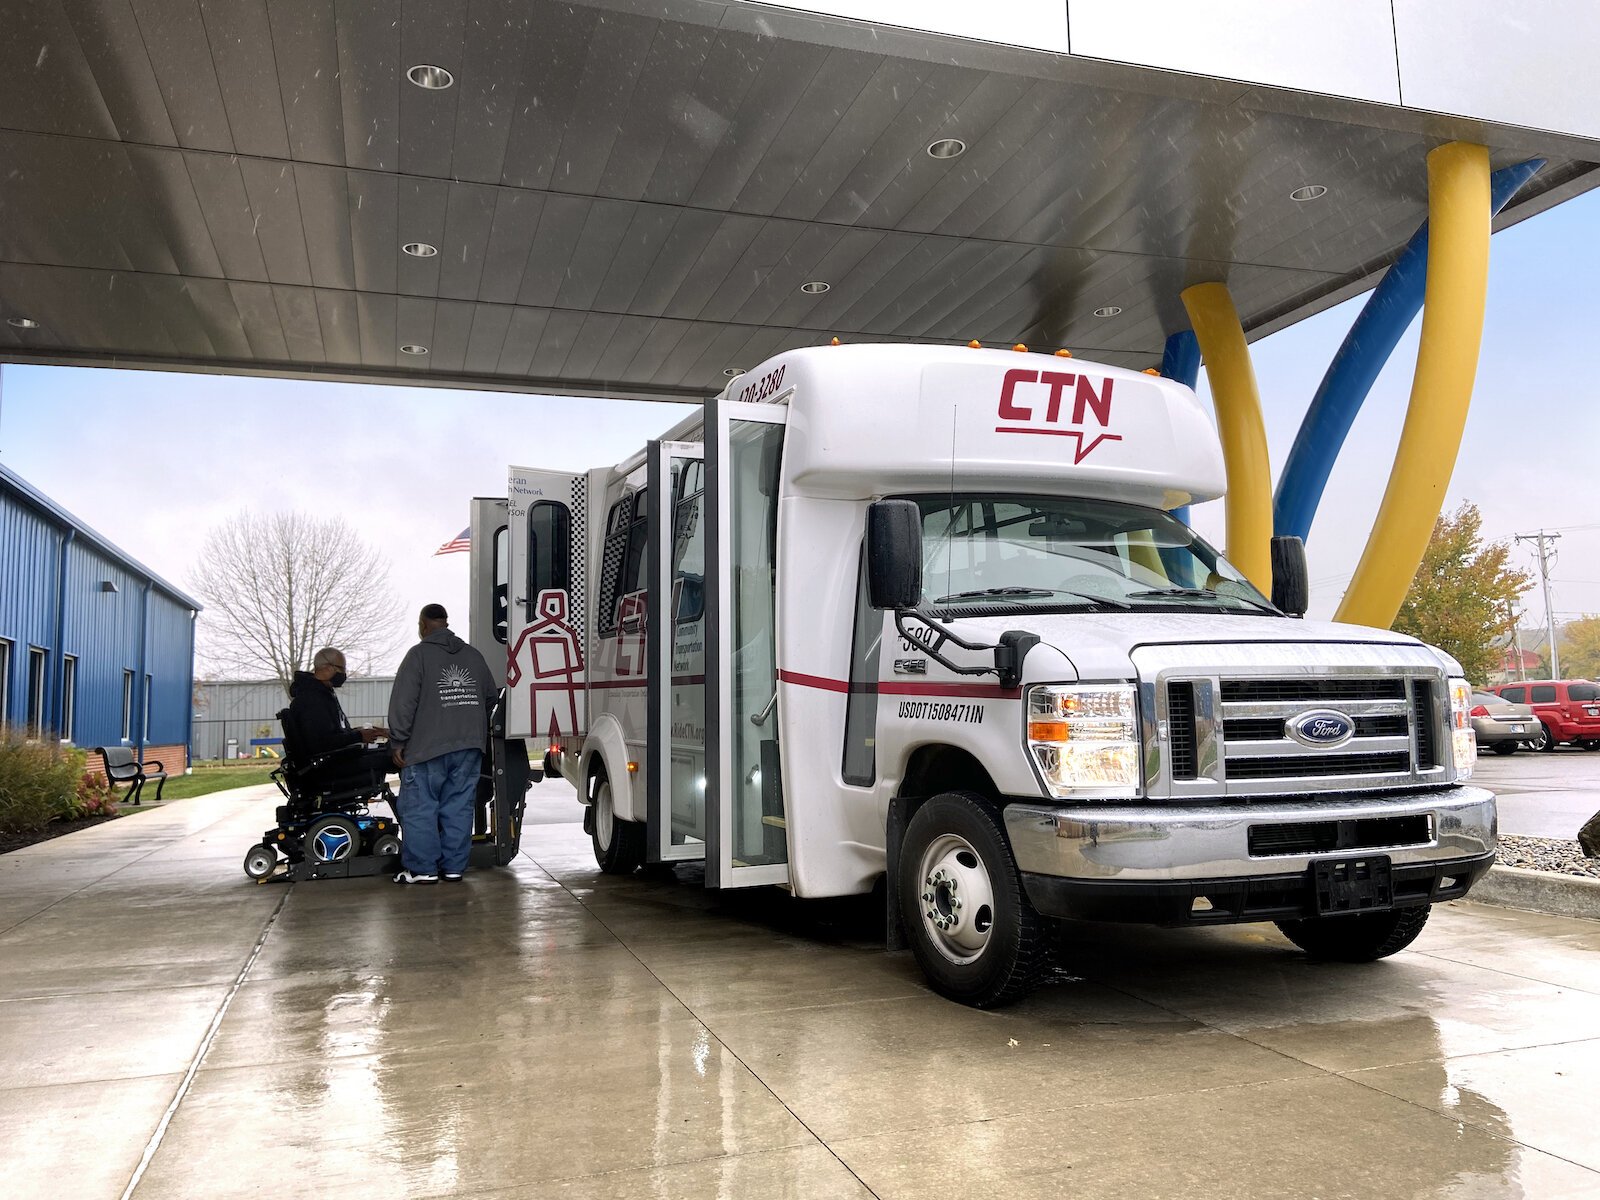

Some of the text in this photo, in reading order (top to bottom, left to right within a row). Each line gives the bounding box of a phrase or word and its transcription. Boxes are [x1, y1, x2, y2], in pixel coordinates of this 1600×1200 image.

[998, 368, 1114, 427] CTN
[513, 486, 544, 496] Network
[508, 508, 526, 517] SOR
[675, 641, 703, 657] Transportation
[674, 658, 690, 672] Network
[1312, 719, 1342, 736] Ford
